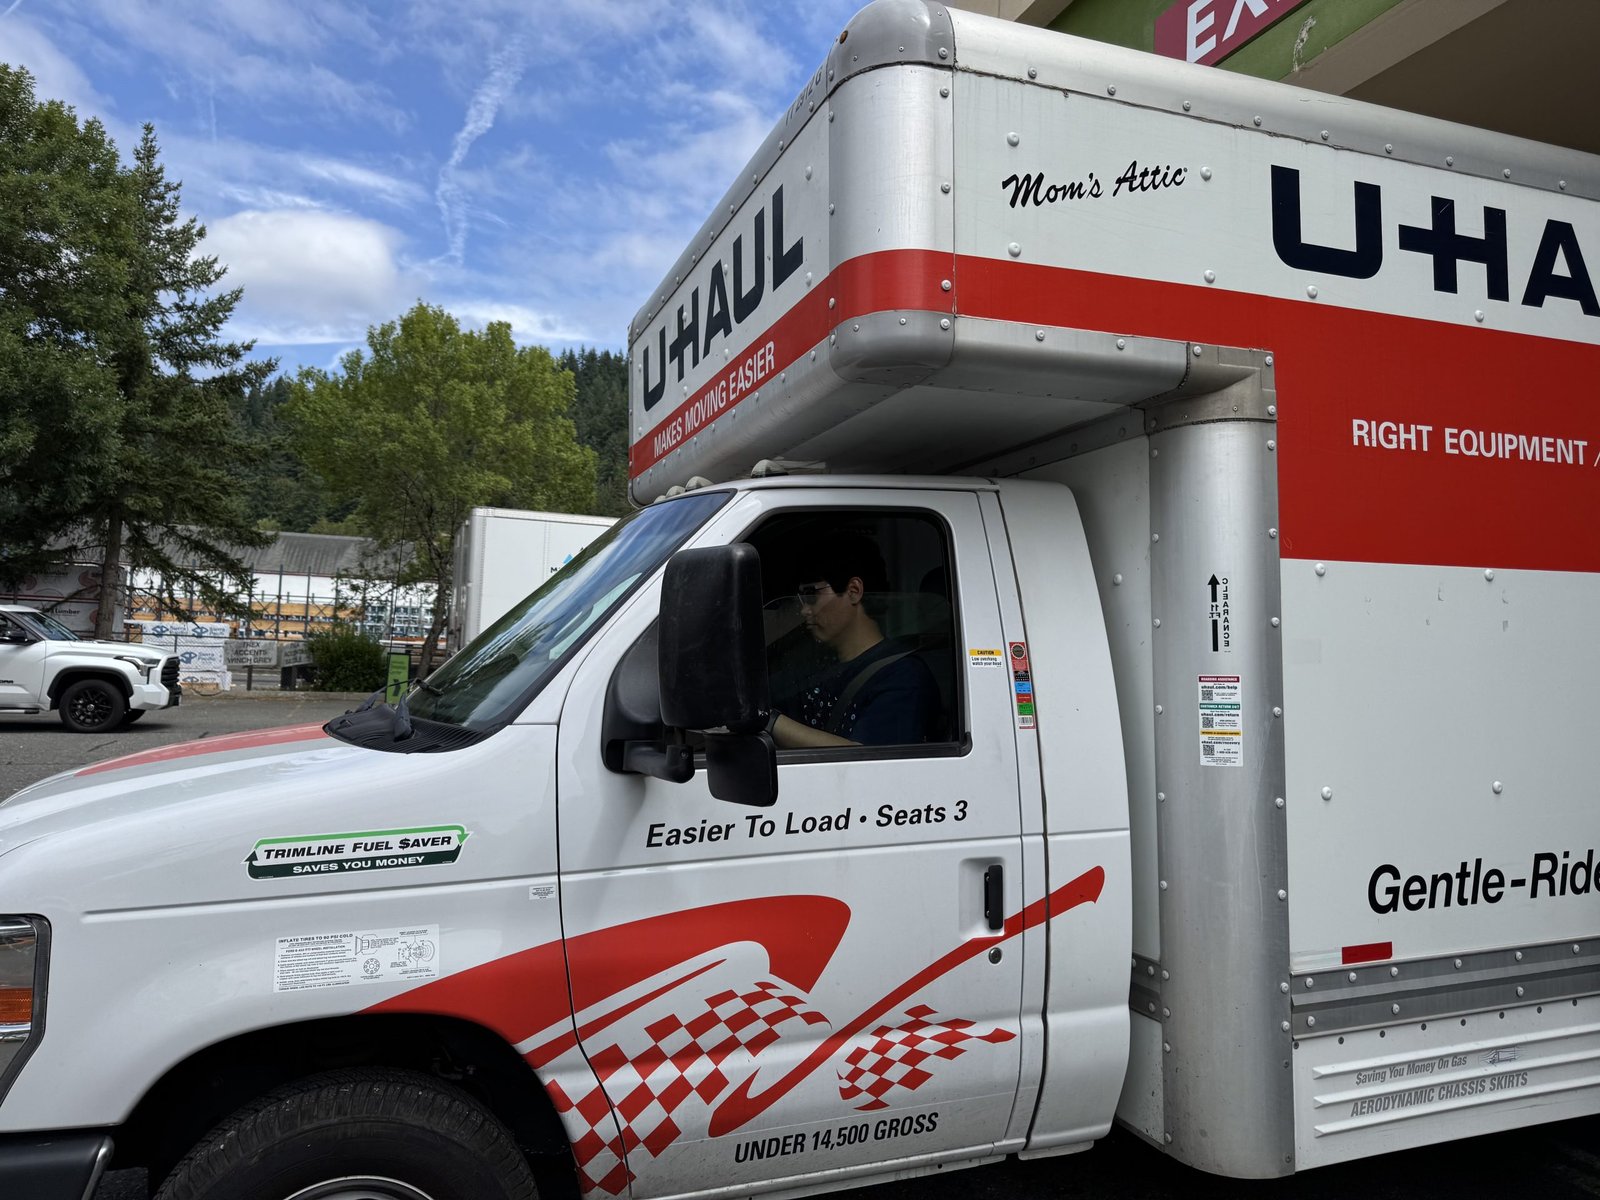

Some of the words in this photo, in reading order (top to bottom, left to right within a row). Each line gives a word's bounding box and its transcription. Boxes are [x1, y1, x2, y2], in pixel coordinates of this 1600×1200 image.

[1002, 172, 1104, 209] Mom's
[643, 184, 804, 412] U-HAUL
[654, 417, 682, 458] MAKES
[685, 380, 726, 435] MOVING
[729, 341, 775, 401] EASIER
[1352, 418, 1433, 452] RIGHT
[1444, 427, 1588, 466] EQUIPMENT
[646, 821, 735, 848] Easier
[745, 813, 775, 838] To
[785, 807, 851, 835] Load
[875, 803, 946, 827] Seats
[954, 799, 968, 822] 3
[264, 845, 345, 860] TRIMLINE
[352, 840, 393, 852] FUEL
[398, 836, 452, 850] $AVER
[343, 860, 371, 869] YOU
[376, 856, 425, 867] MONEY
[1389, 1066, 1405, 1079] You
[1407, 1060, 1436, 1075] Money
[1437, 1057, 1449, 1069] On
[1451, 1055, 1467, 1067] Gas
[1350, 1088, 1435, 1117] AERODYNAMIC
[1438, 1078, 1486, 1101] CHASSIS
[1489, 1072, 1528, 1091] SKIRTS
[735, 1133, 806, 1163] UNDER
[812, 1123, 869, 1151] 14,500
[874, 1112, 939, 1141] GROSS
